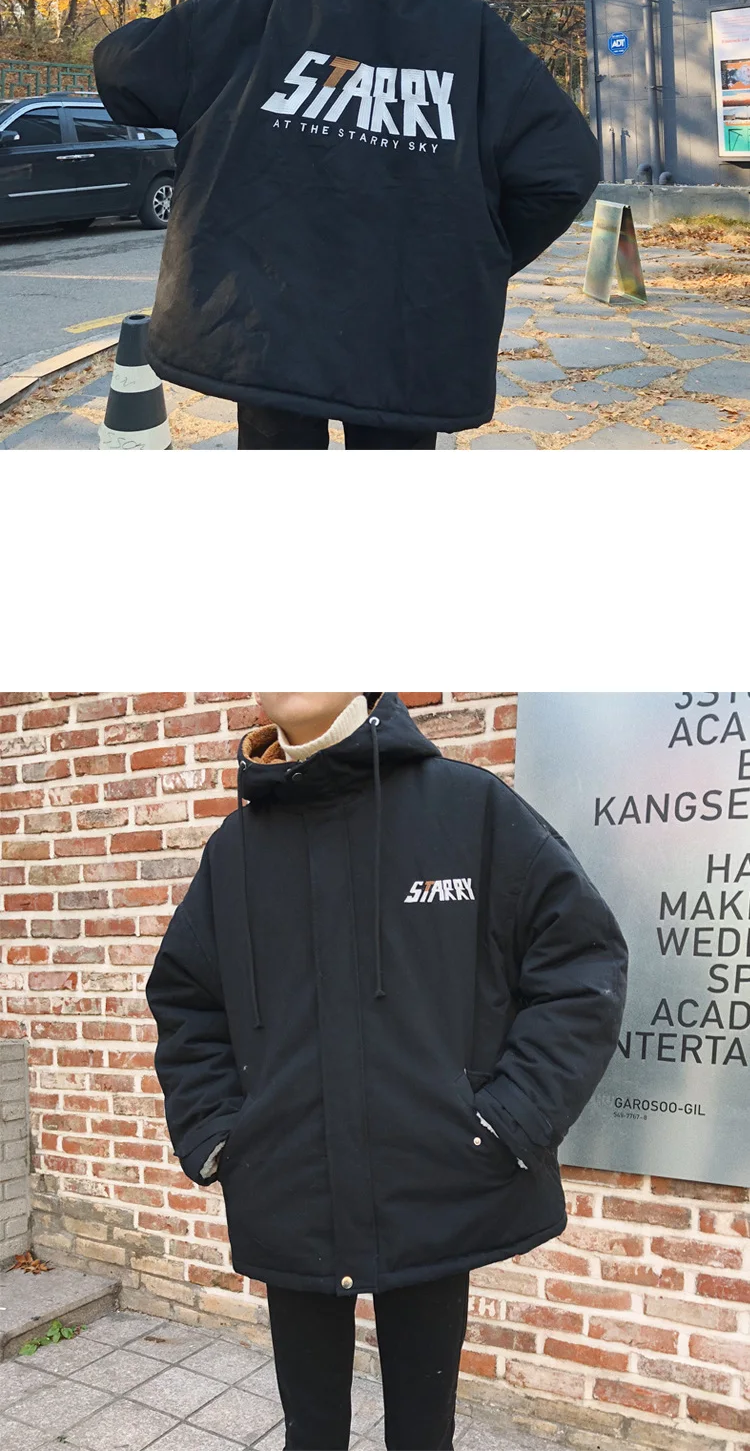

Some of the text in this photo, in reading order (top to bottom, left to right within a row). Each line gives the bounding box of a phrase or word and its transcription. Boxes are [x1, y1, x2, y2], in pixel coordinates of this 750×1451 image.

[611, 38, 626, 48] ADT
[260, 50, 456, 141] STARRY
[272, 119, 439, 154] AT THE STARRY SKY
[667, 711, 747, 749] ACA
[594, 787, 750, 826] KANGSE
[403, 877, 476, 904] STARRY
[659, 890, 750, 920] MAK
[656, 927, 750, 957] WED
[650, 998, 750, 1030] ACAD
[614, 1097, 706, 1116] GAROSOO-GIL
